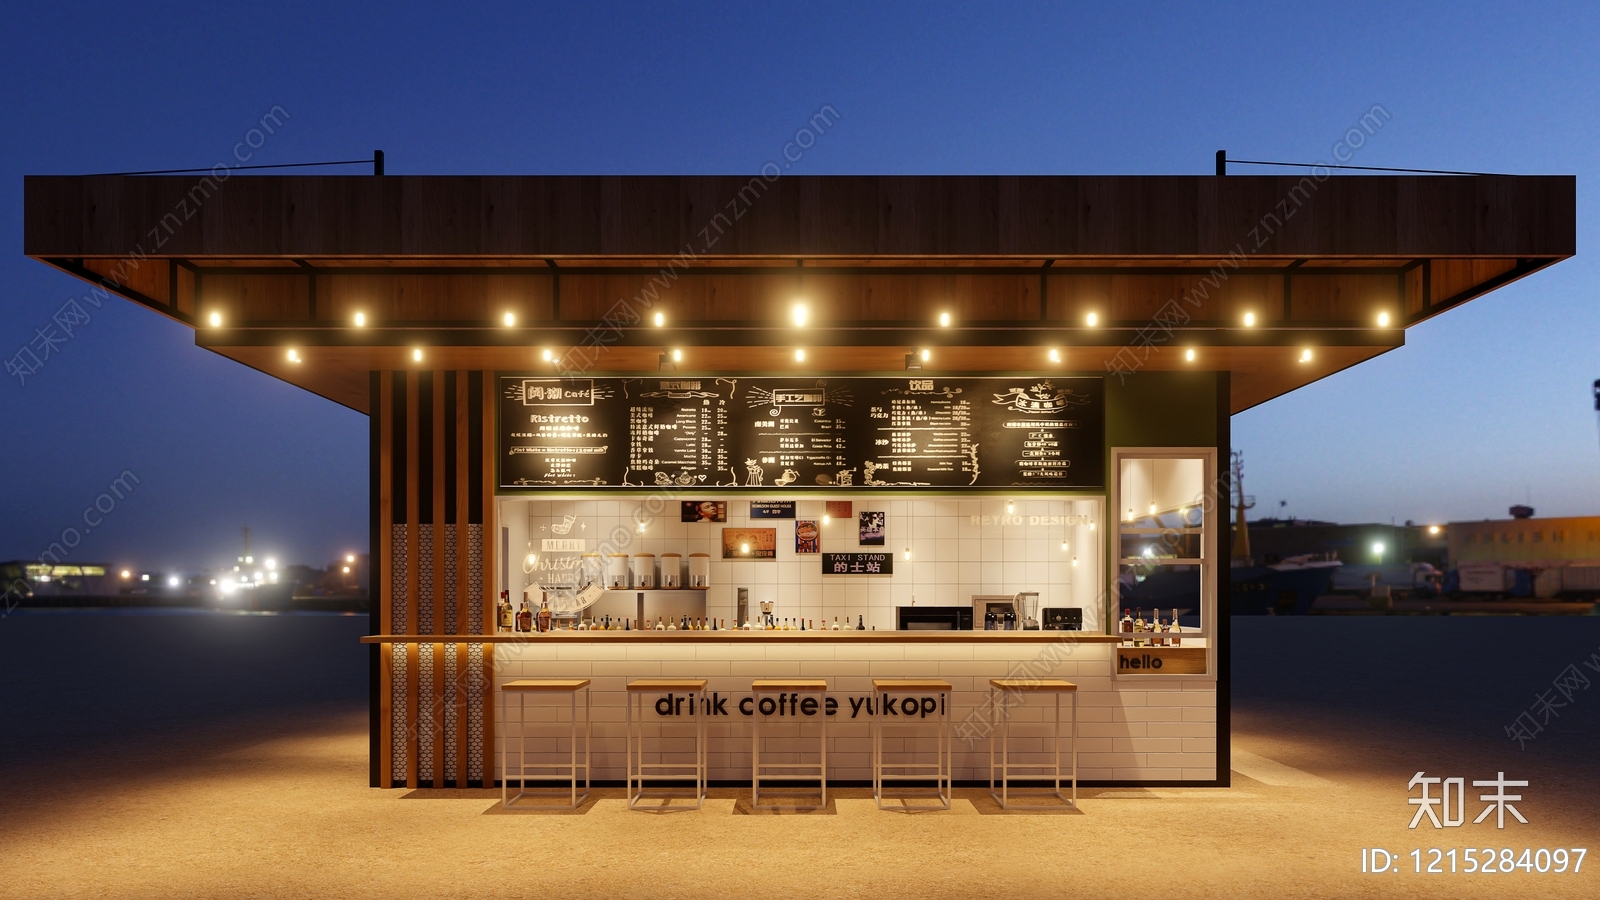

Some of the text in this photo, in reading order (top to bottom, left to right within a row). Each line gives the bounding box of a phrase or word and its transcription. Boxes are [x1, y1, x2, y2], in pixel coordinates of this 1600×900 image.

[909, 380, 934, 391] 饮品
[564, 389, 590, 398] Café
[530, 414, 589, 423] Ristretto
[970, 515, 1088, 526] RETRO DESIGN
[546, 540, 580, 550] MERRY
[834, 562, 881, 573] 的士站
[1120, 654, 1162, 669] hello
[655, 693, 945, 718] drink coffee yukopi
